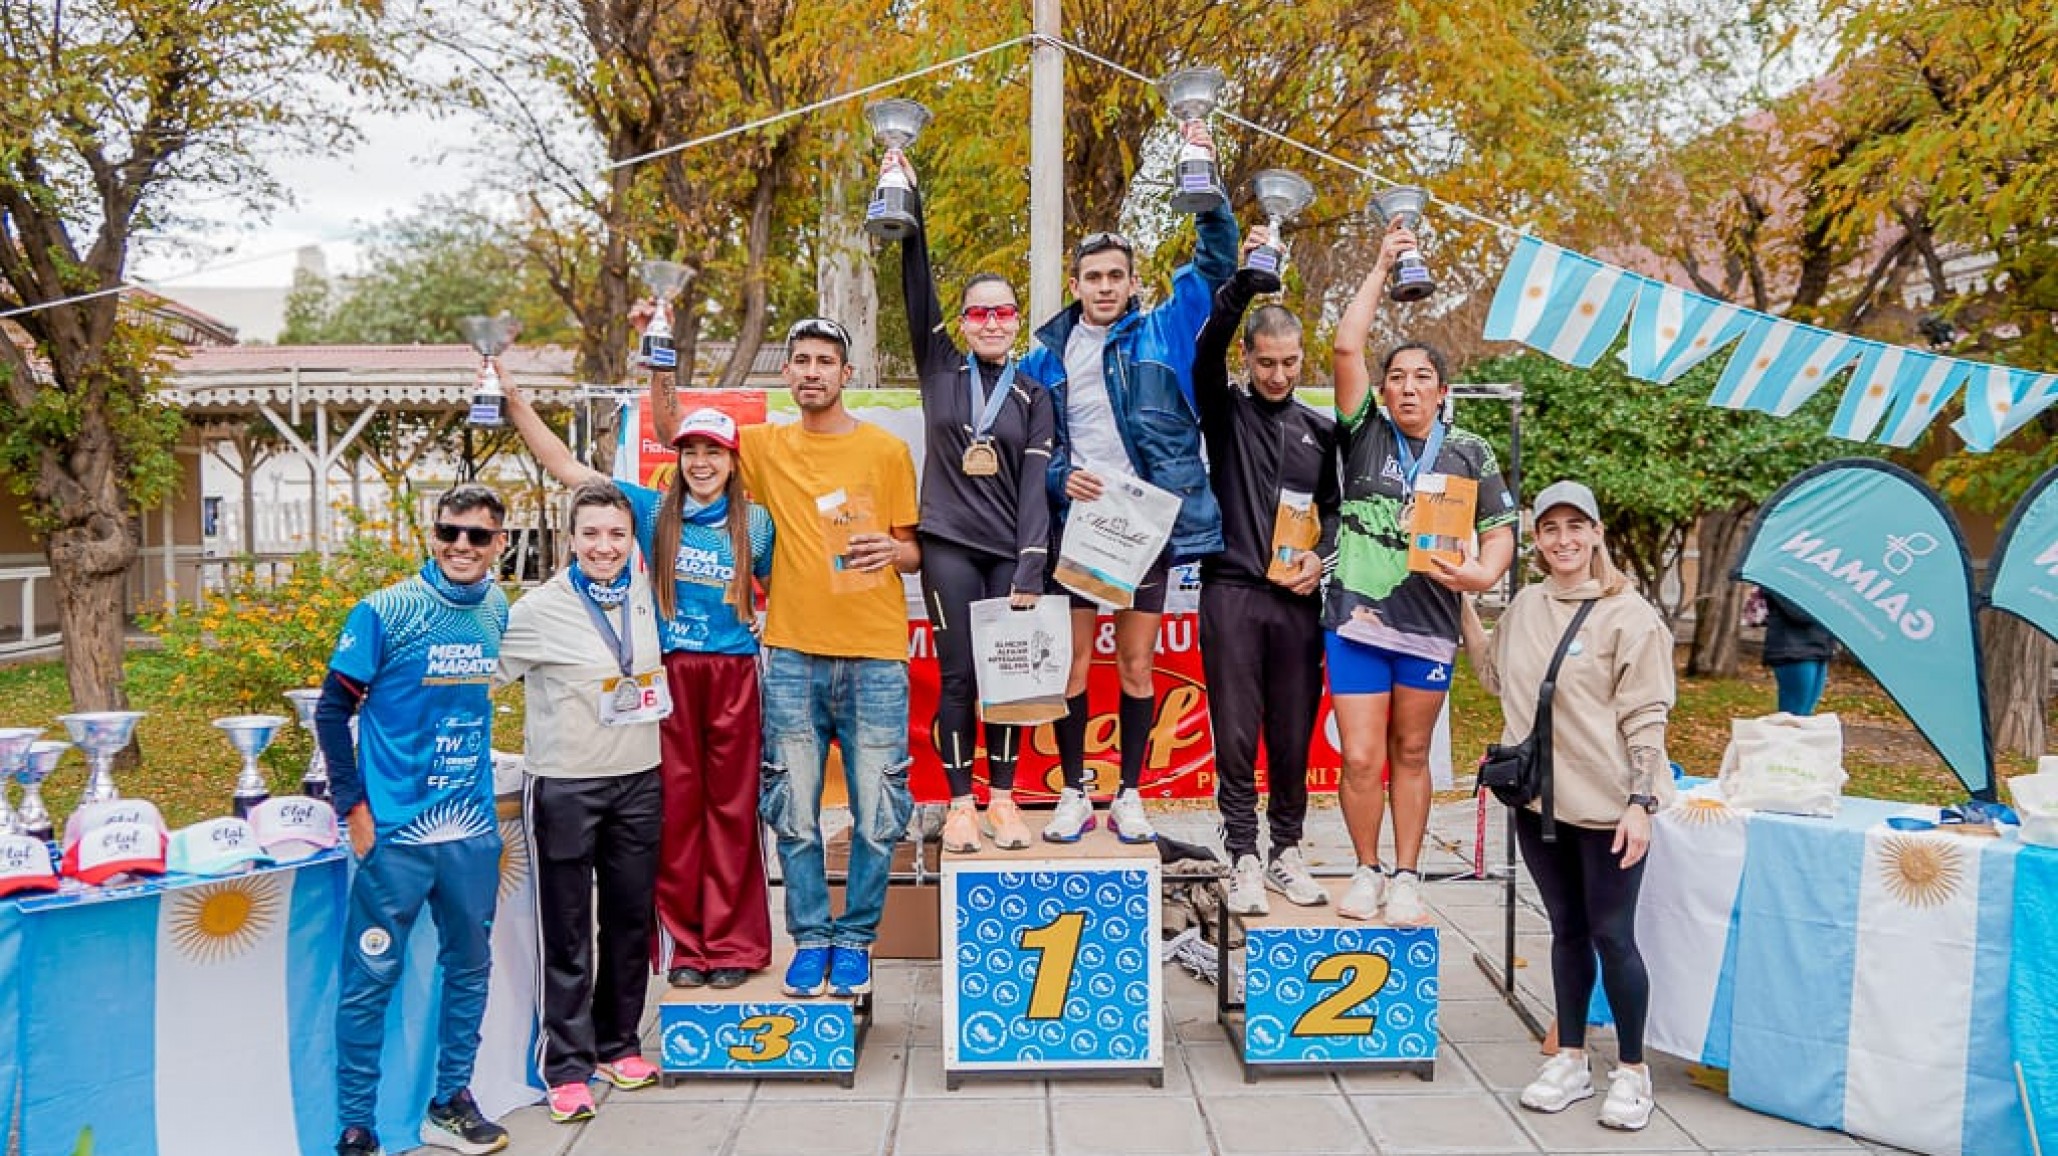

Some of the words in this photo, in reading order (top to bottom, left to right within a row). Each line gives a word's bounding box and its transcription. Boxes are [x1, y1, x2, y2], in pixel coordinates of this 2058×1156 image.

[678, 546, 718, 565] EDIA
[675, 559, 735, 580] ARATO
[428, 643, 483, 660] MEDIA
[427, 658, 499, 675] MARATO
[0, 842, 31, 860] laf
[1020, 911, 1085, 1020] 1
[1290, 951, 1392, 1037] 2
[727, 1014, 798, 1062] 3
